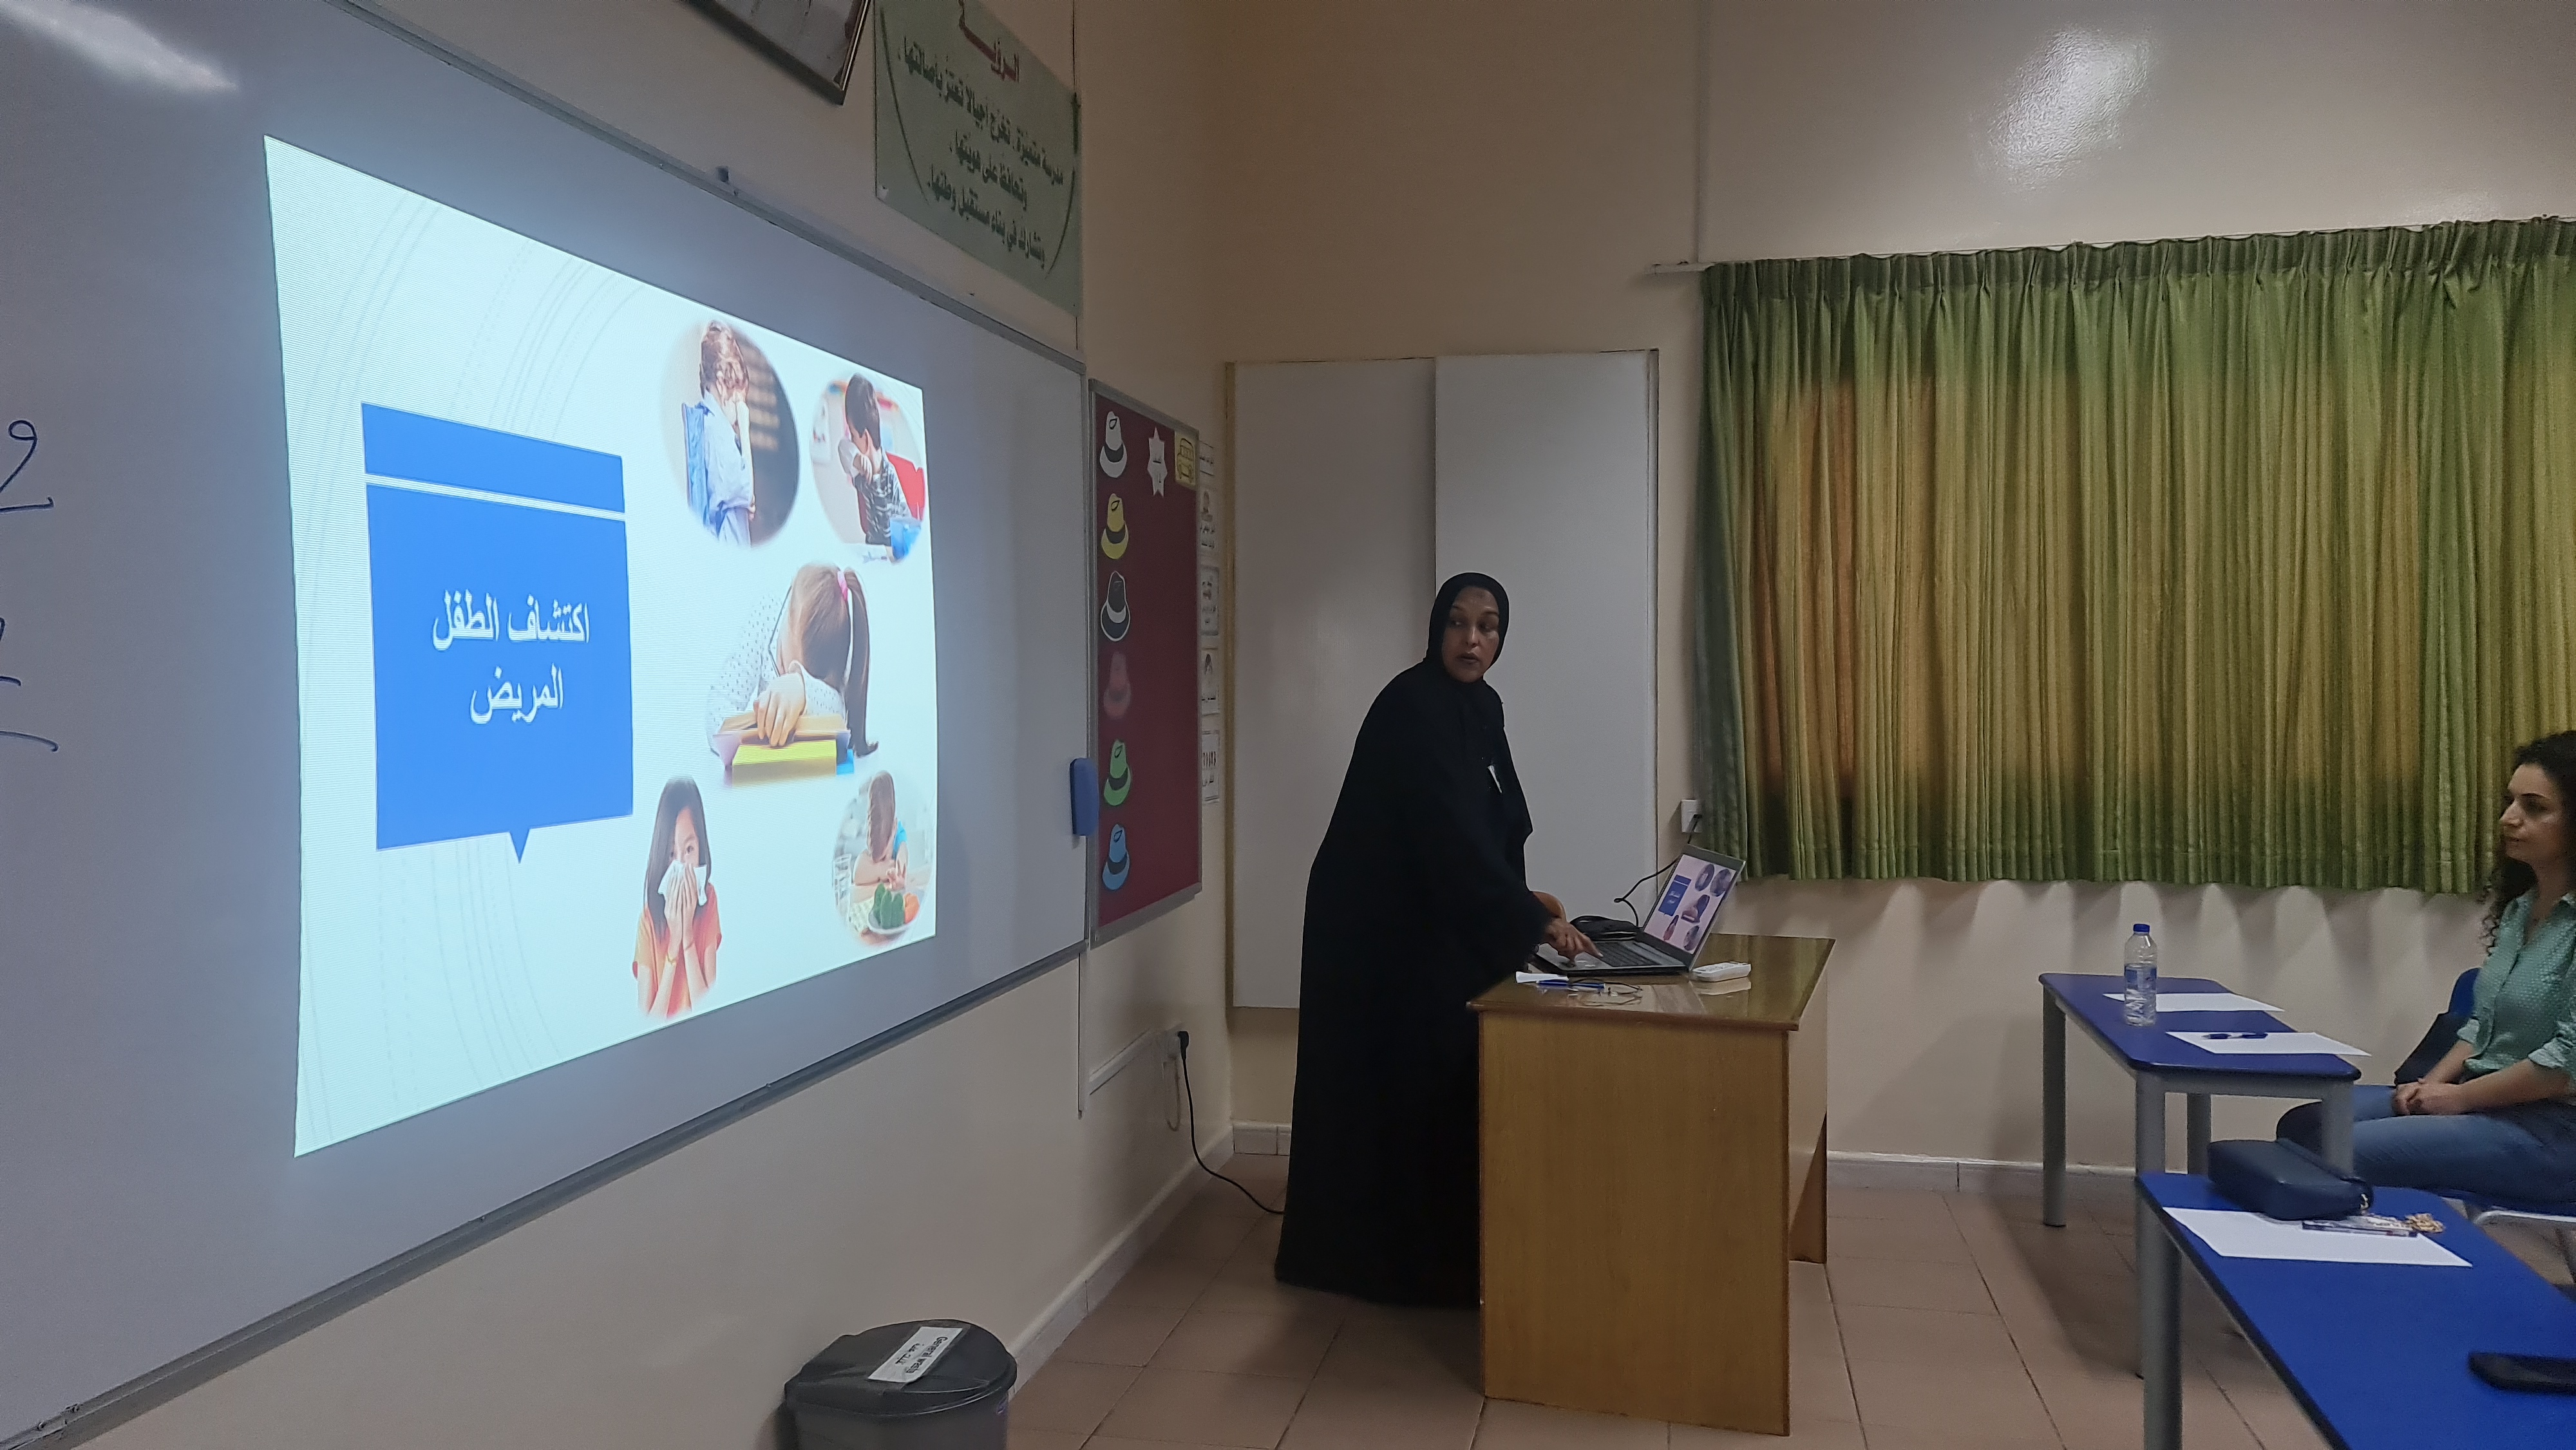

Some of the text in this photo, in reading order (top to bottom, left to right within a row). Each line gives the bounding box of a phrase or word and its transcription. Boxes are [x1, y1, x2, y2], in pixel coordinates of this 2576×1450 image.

[431, 588, 590, 652] اكتشاف الطفل
[469, 662, 565, 725] المريض
